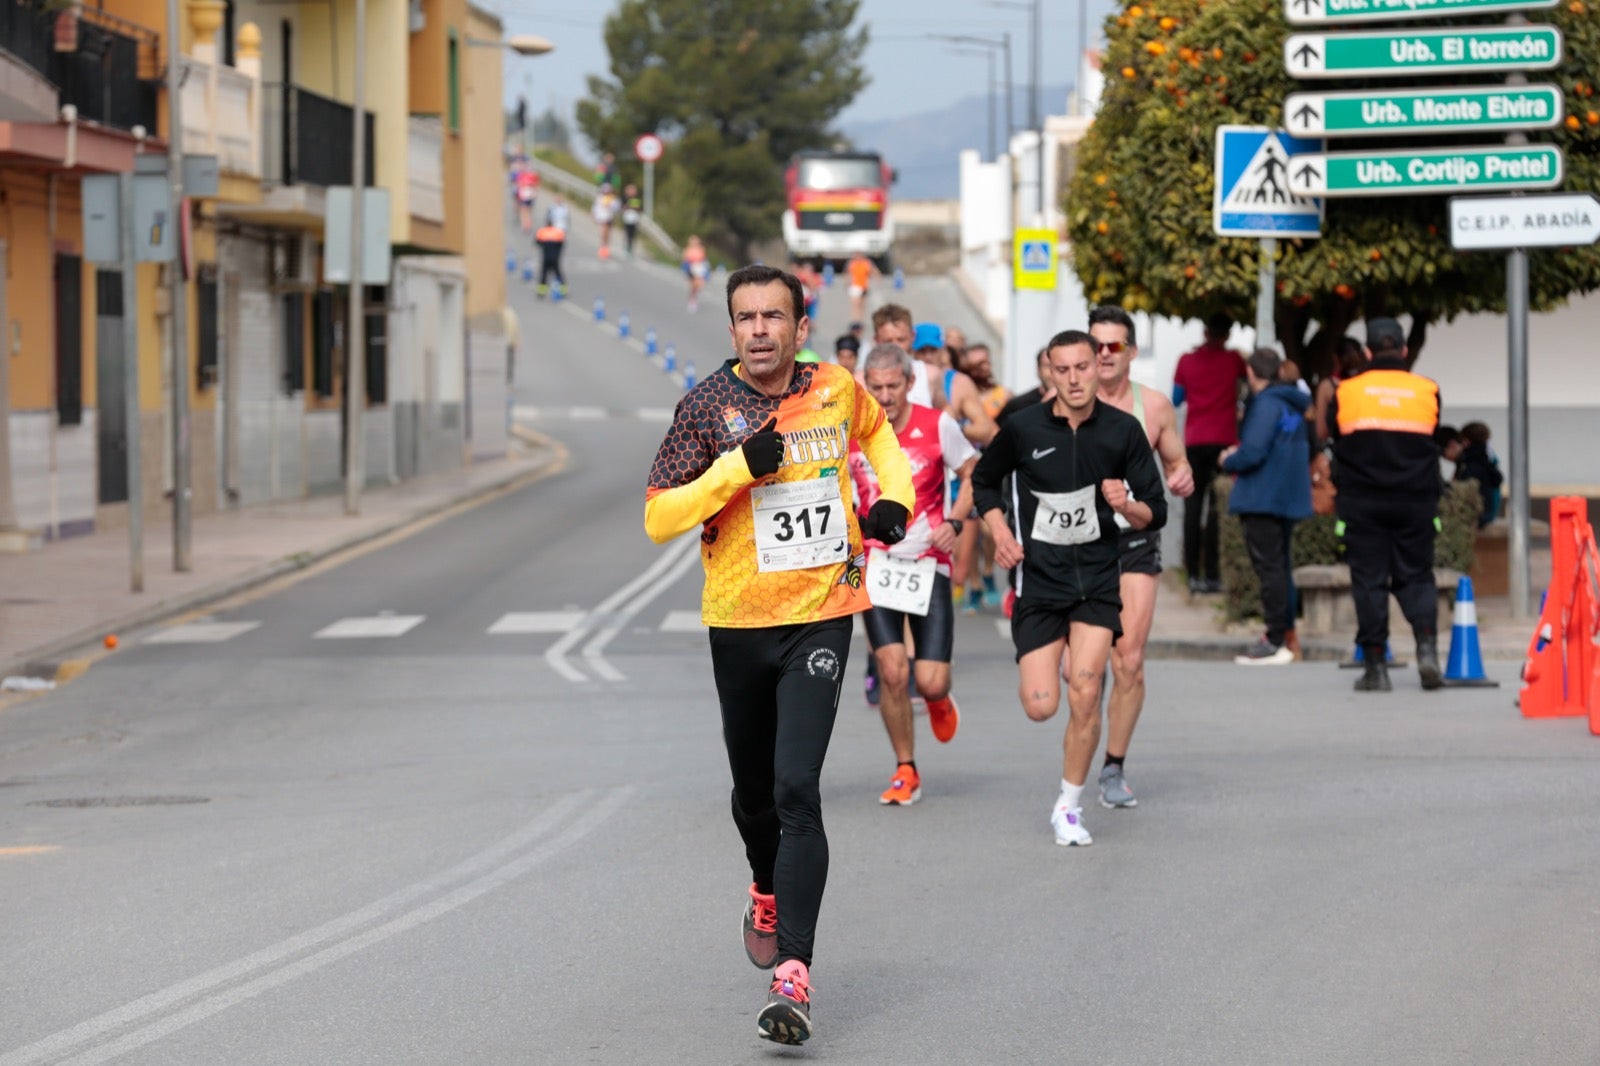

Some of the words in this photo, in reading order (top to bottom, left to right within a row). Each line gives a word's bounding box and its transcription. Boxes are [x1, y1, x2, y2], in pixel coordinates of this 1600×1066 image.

[1391, 39, 1436, 62] Urb.
[1442, 37, 1464, 61] El
[1469, 35, 1548, 60] torreón
[1362, 101, 1407, 124] Urb.
[1413, 98, 1482, 122] Monte
[1487, 95, 1548, 119] Elvira
[1357, 160, 1402, 183] Urb.
[1408, 157, 1479, 184] Cortijo
[1485, 154, 1549, 178] Pretel
[1523, 208, 1592, 228] ABADÍA
[782, 426, 837, 444] eportivo
[773, 505, 831, 542] 317
[1048, 507, 1087, 529] 792
[879, 569, 921, 593] 375
